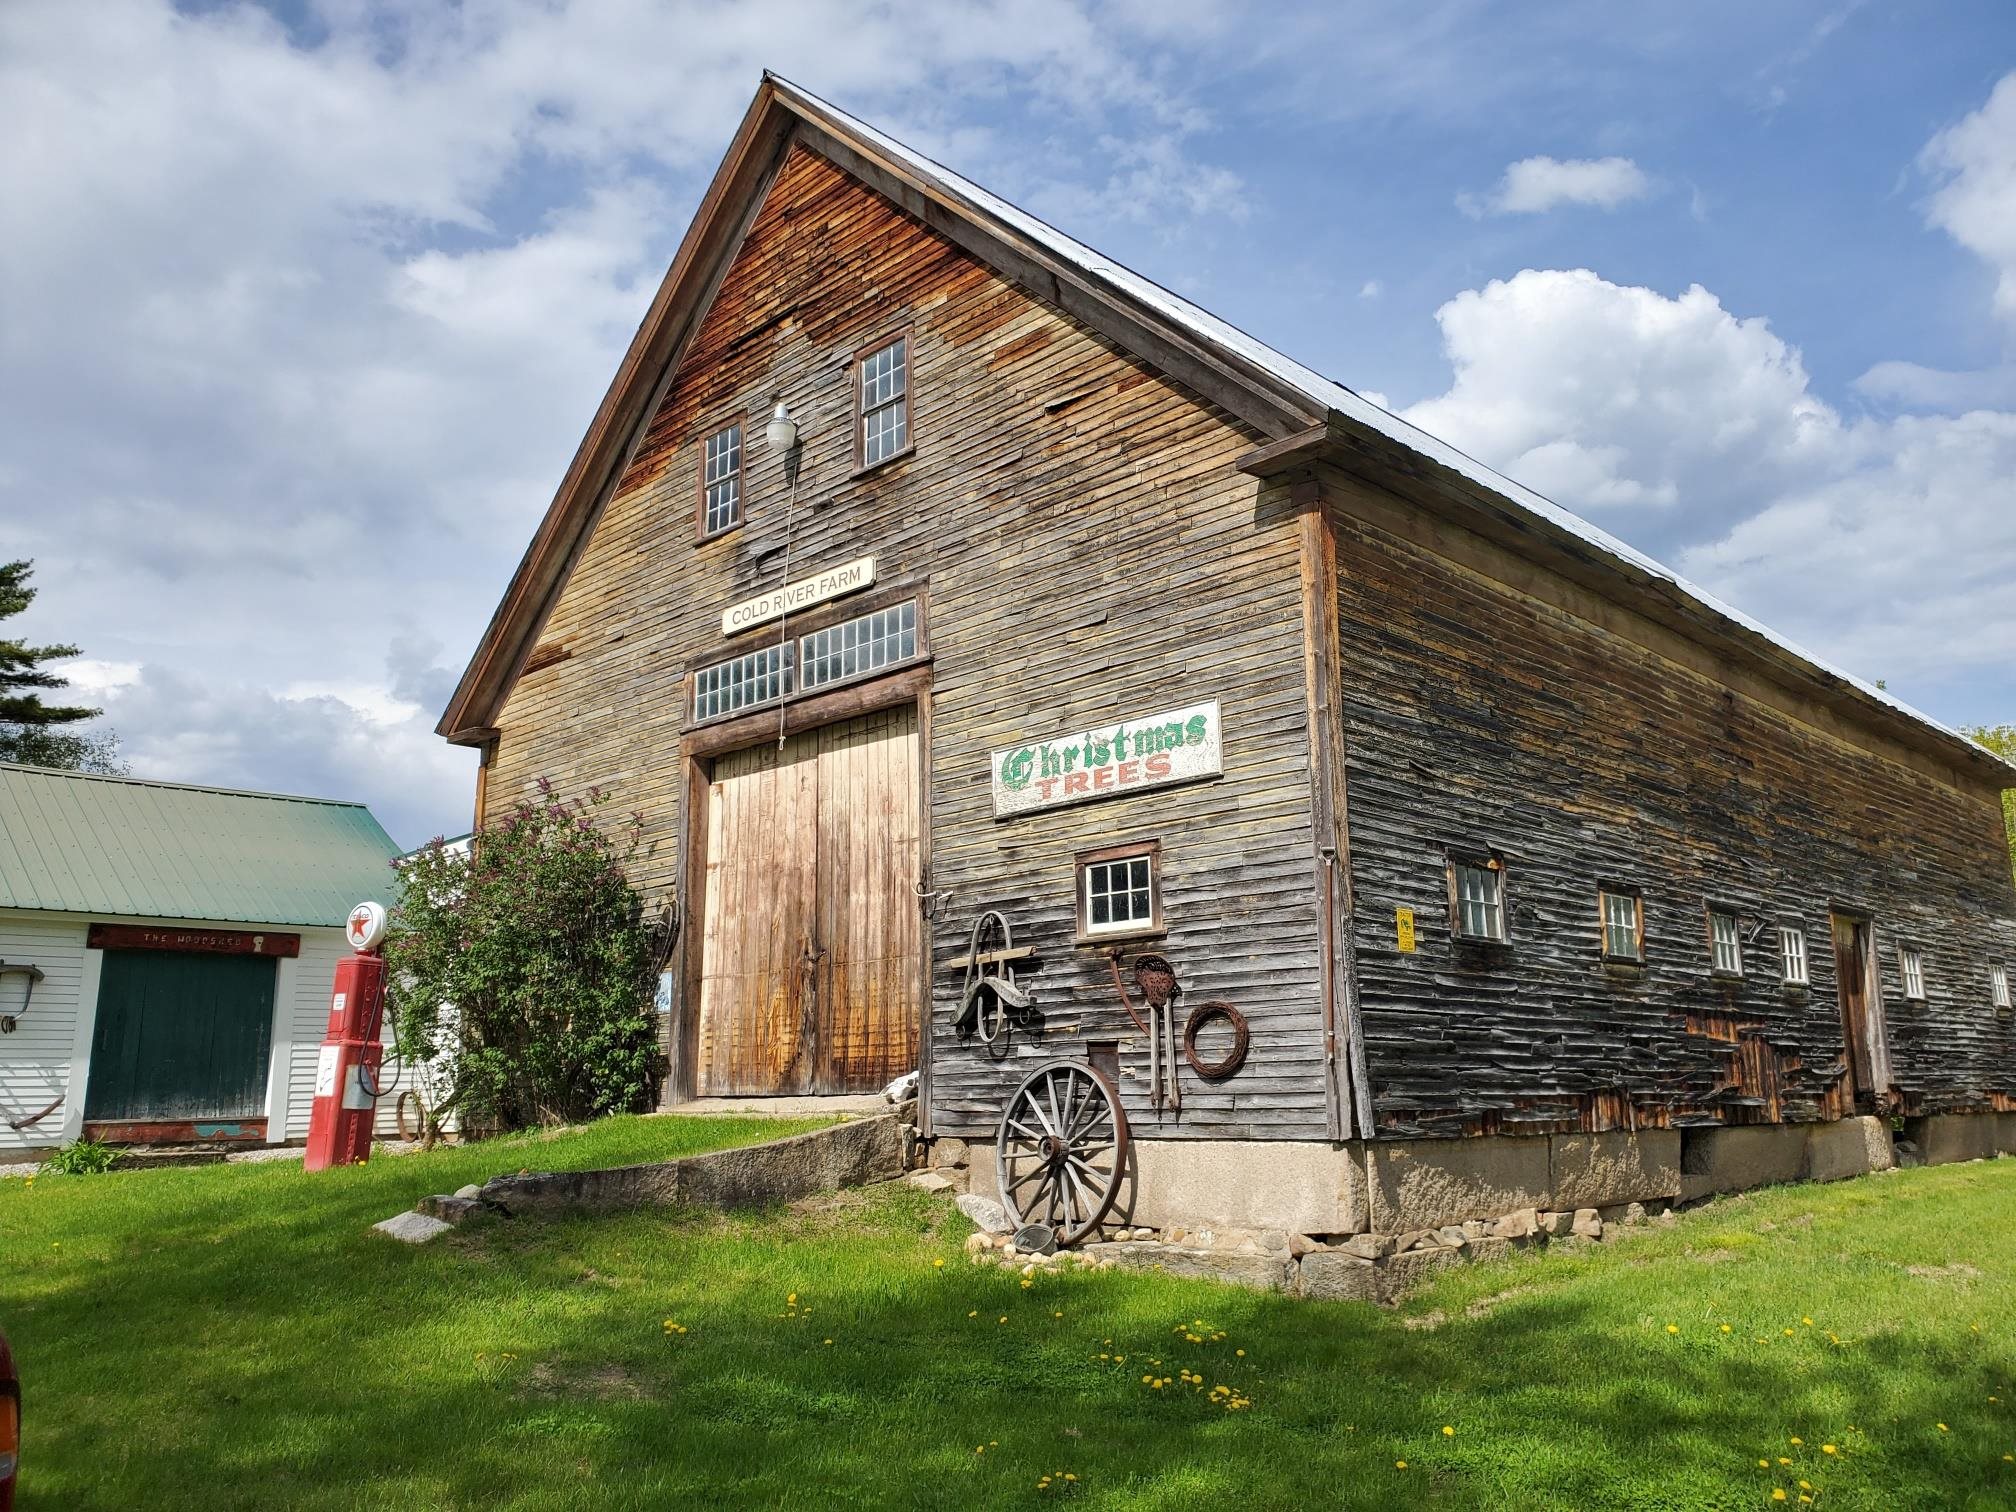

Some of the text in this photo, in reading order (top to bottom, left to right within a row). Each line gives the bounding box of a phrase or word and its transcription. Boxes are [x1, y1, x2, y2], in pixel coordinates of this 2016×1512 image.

[732, 566, 861, 625] COLD RIVER FARM
[1001, 714, 1208, 792] Christmas
[1035, 753, 1171, 800] TREES
[144, 933, 168, 944] THE
